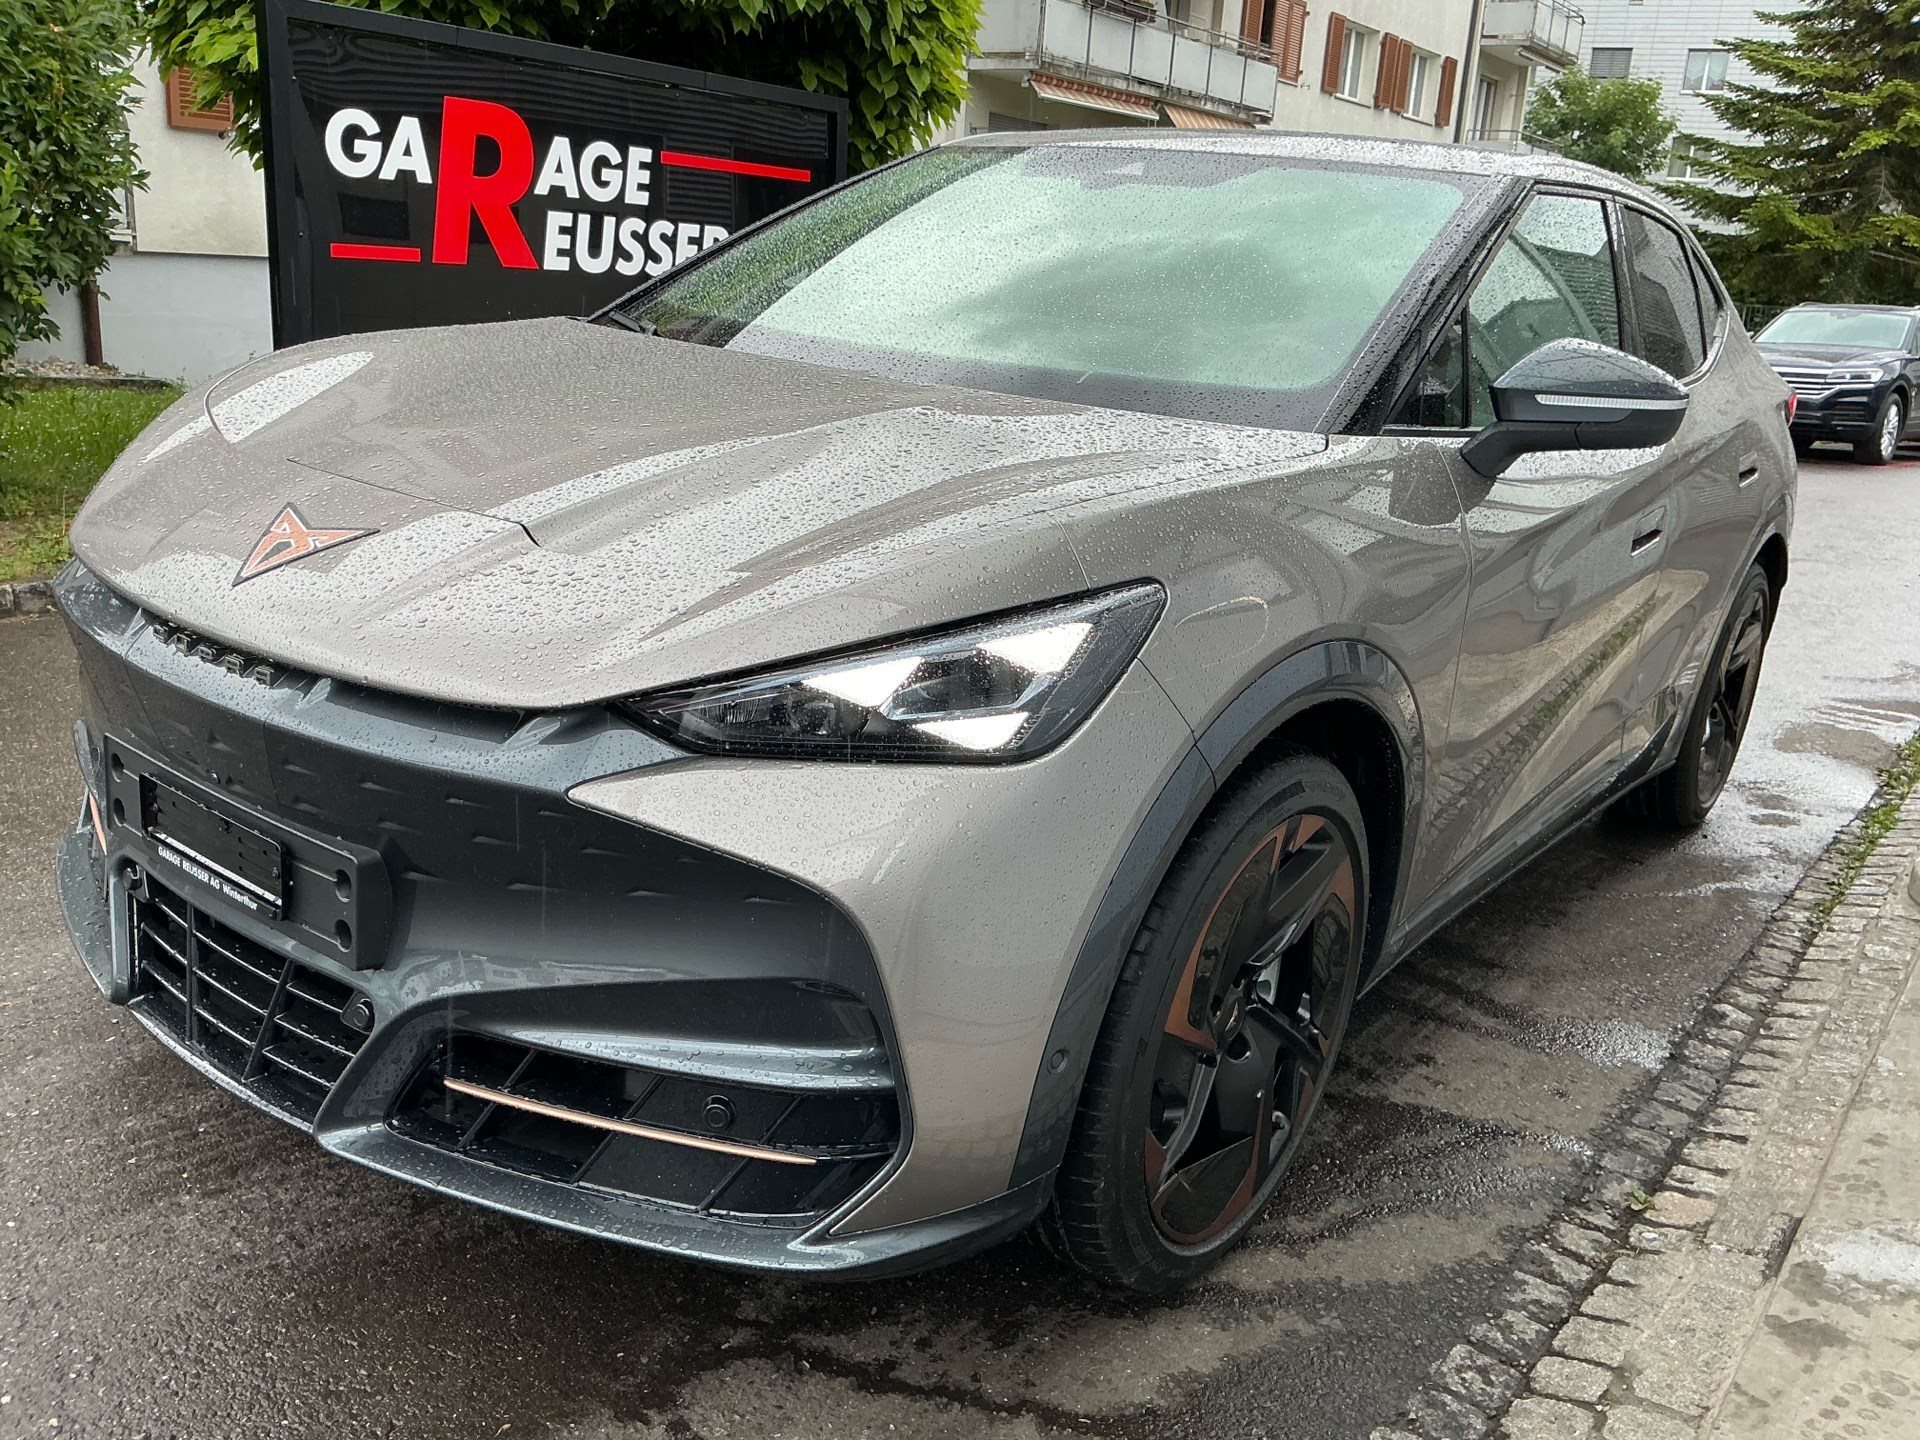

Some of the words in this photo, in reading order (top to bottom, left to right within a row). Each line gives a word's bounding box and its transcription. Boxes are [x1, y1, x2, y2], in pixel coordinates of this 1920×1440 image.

[324, 96, 653, 270] GARAGE
[157, 845, 181, 868] GARAGE
[182, 859, 209, 884] REUSSER
[209, 876, 220, 890] AG
[222, 883, 258, 911] Winterthur
